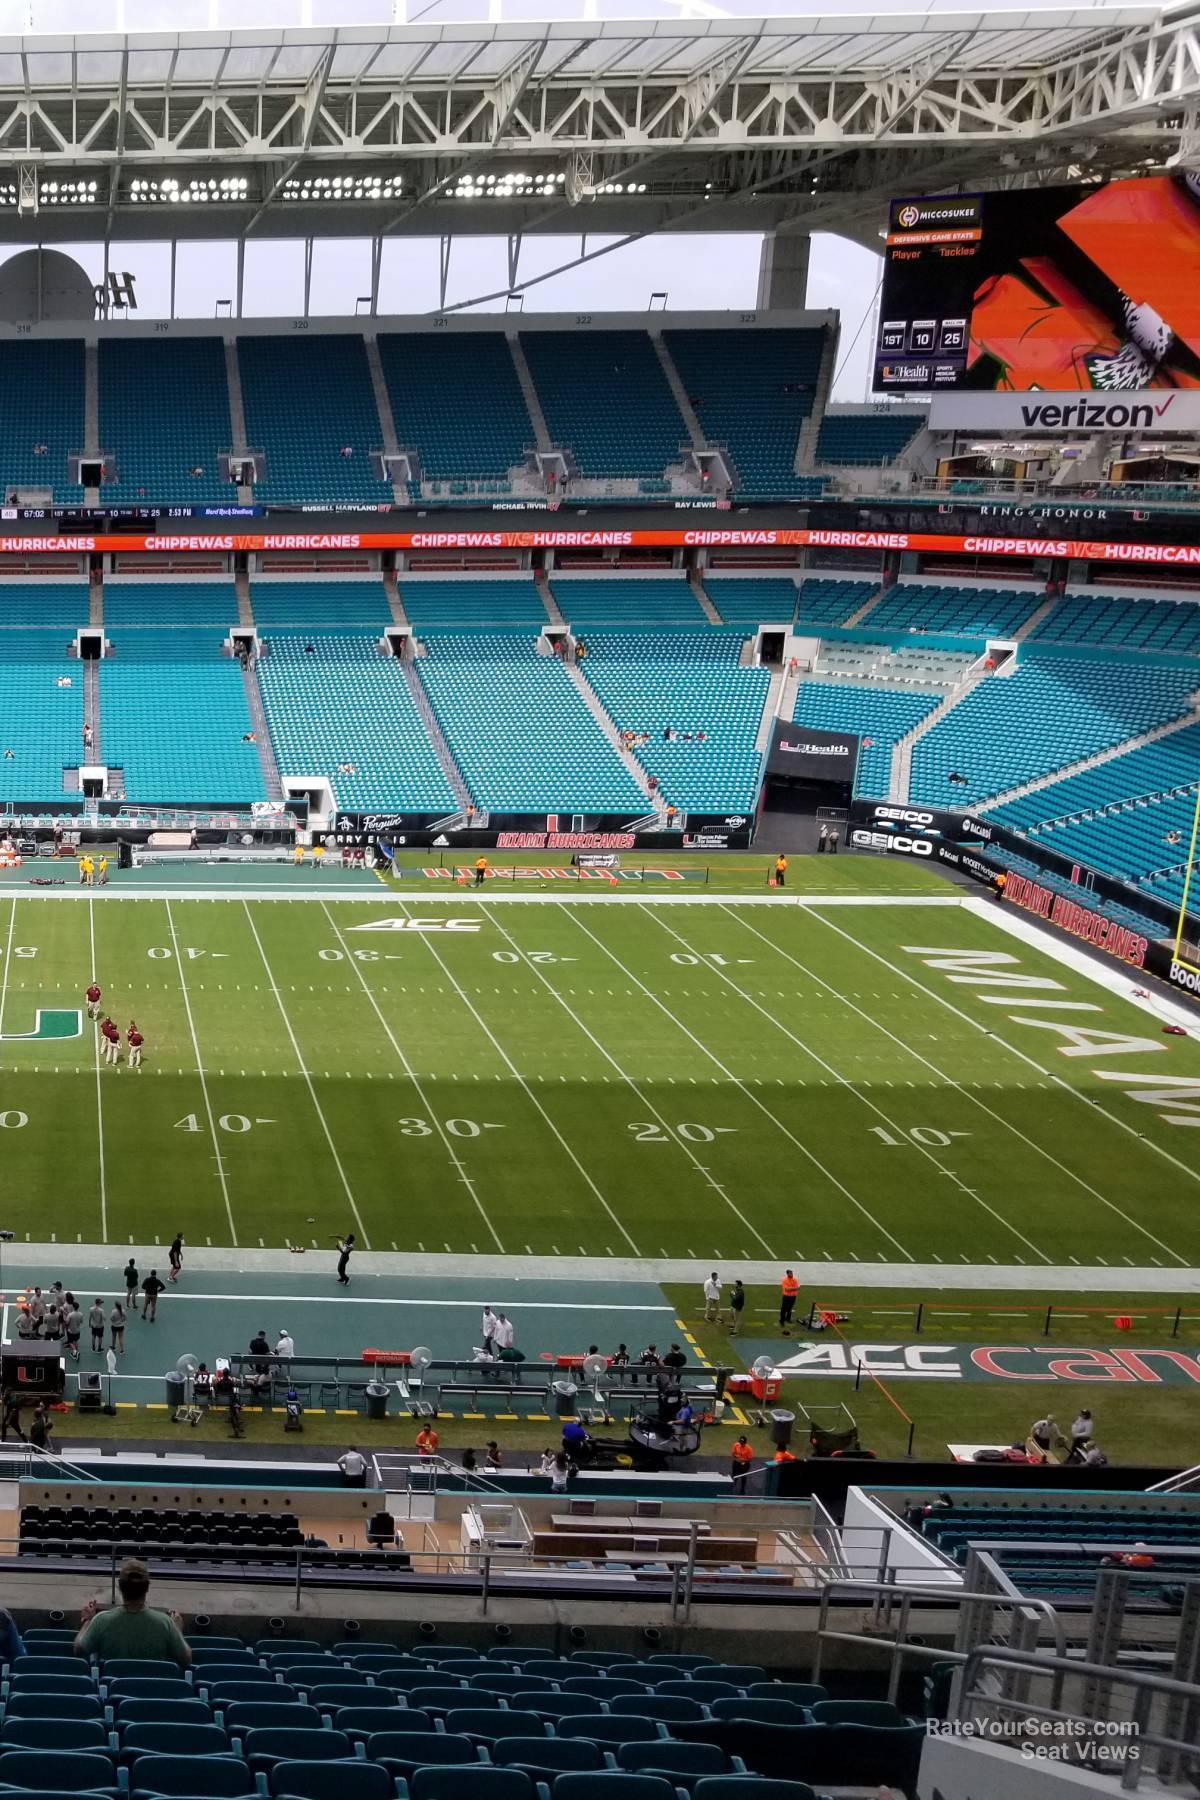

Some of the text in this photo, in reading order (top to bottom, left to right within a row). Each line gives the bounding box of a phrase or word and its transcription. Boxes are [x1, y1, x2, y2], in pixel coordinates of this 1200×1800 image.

[919, 207, 975, 220] MICCOSUKEE
[894, 235, 930, 243] DEFENSIVE
[892, 250, 922, 260] Player
[292, 320, 308, 329] 320
[433, 318, 448, 328] 321
[576, 316, 591, 325] 322
[740, 314, 756, 323] 323
[154, 323, 169, 331] 319
[884, 334, 902, 344] 1ST
[916, 334, 929, 345] 10
[944, 333, 960, 344] 25
[1021, 398, 1154, 428] verizon
[302, 504, 377, 512] RUSSELL MARYLAND
[675, 501, 690, 509] RAY
[691, 501, 716, 509] LEWIS
[23, 510, 45, 518] 67:02
[980, 505, 1107, 519] RING HONOR
[1, 537, 95, 550] HURRICANES
[145, 534, 360, 550] CHIPPEWAS HURRICANES
[411, 531, 632, 547] CHIPPEWAS HURRICANES
[684, 531, 908, 548] CHIPPEWAS HURRICANES
[963, 537, 1068, 556] CHIPPEWAS
[874, 806, 933, 825] GEICO
[363, 815, 402, 831] Penguin
[320, 835, 362, 844] PRRY
[496, 832, 635, 849] MIAMI HURRICANES
[852, 829, 933, 856] GEICO
[346, 917, 483, 931] ACC
[1003, 869, 1149, 967] MIAMI HURRICANES
[172, 1112, 253, 1134] 40
[397, 1116, 481, 1138] 30
[625, 1121, 716, 1144] 20
[772, 1342, 962, 1378] ACC
